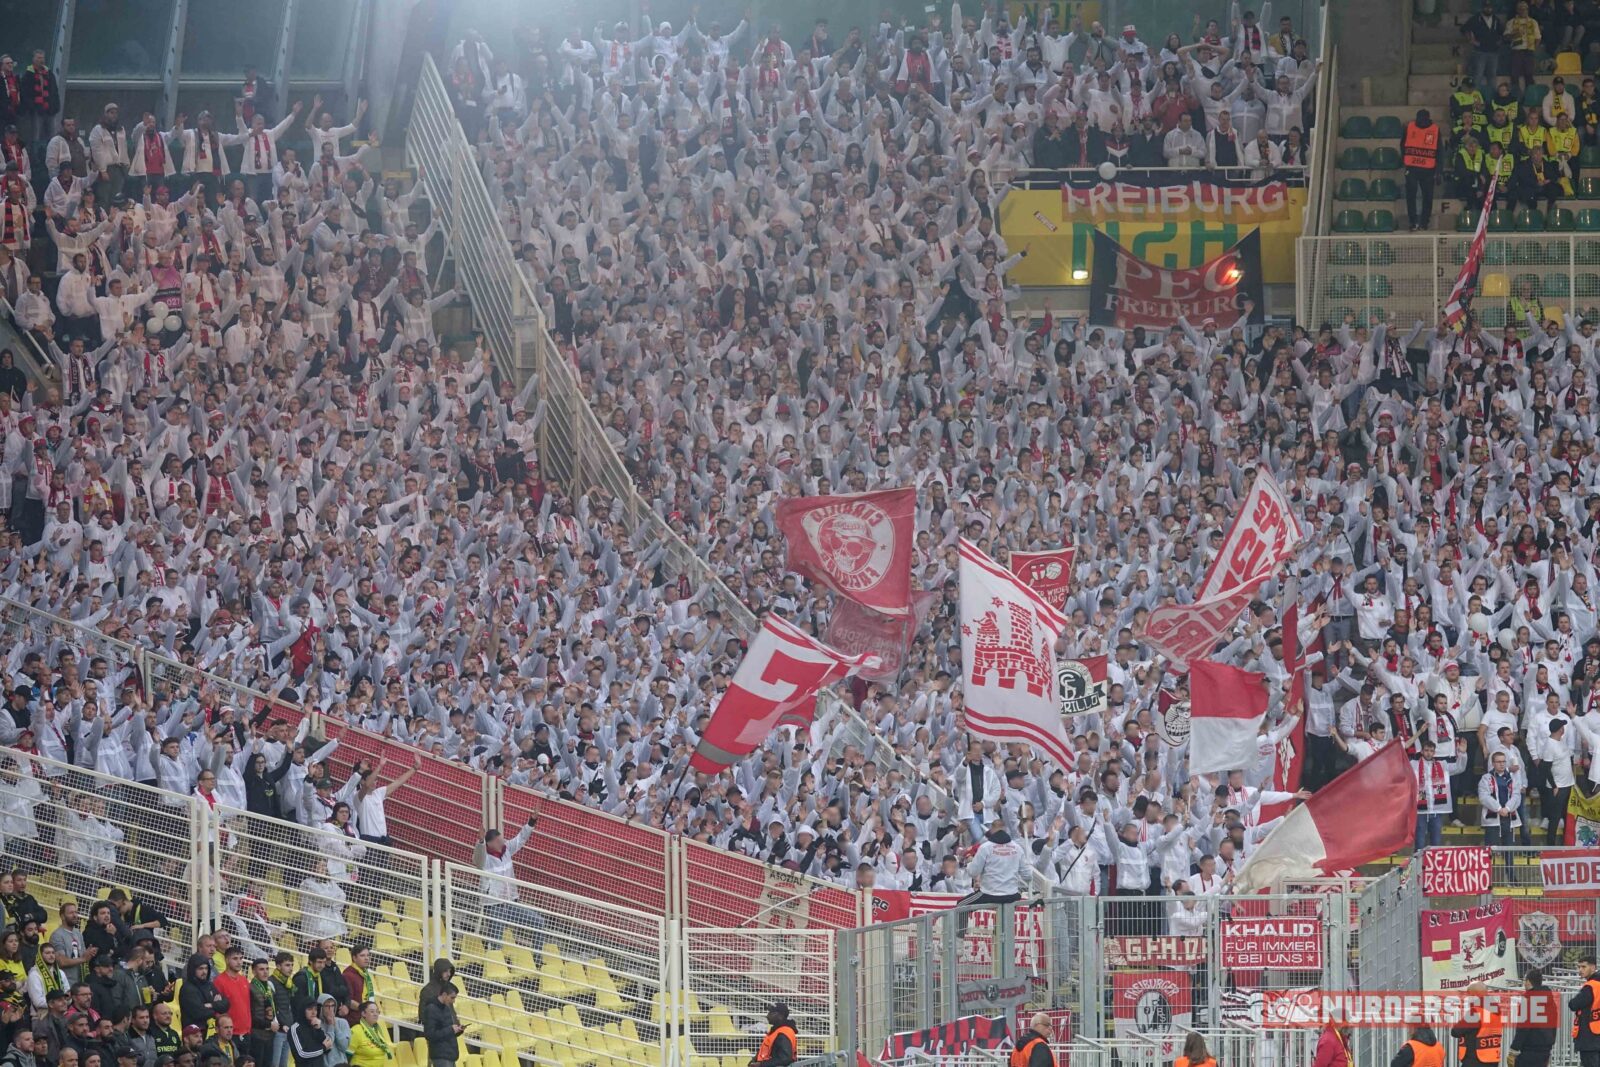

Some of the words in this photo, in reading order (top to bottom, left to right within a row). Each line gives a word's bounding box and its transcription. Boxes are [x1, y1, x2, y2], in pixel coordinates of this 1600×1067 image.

[1066, 181, 1285, 216] FREIBURG
[1104, 292, 1250, 318] FREIBURG
[975, 656, 1042, 678] SYNTHE
[1424, 847, 1490, 872] SEZIONE
[1424, 869, 1491, 894] BERLINO
[1225, 922, 1315, 938] KHALID
[1225, 939, 1258, 952] FÜR
[1262, 941, 1316, 951] IMMER
[1238, 953, 1263, 964] BEI
[1267, 953, 1303, 964] UNS
[1123, 978, 1181, 1001] FREIBURGER
